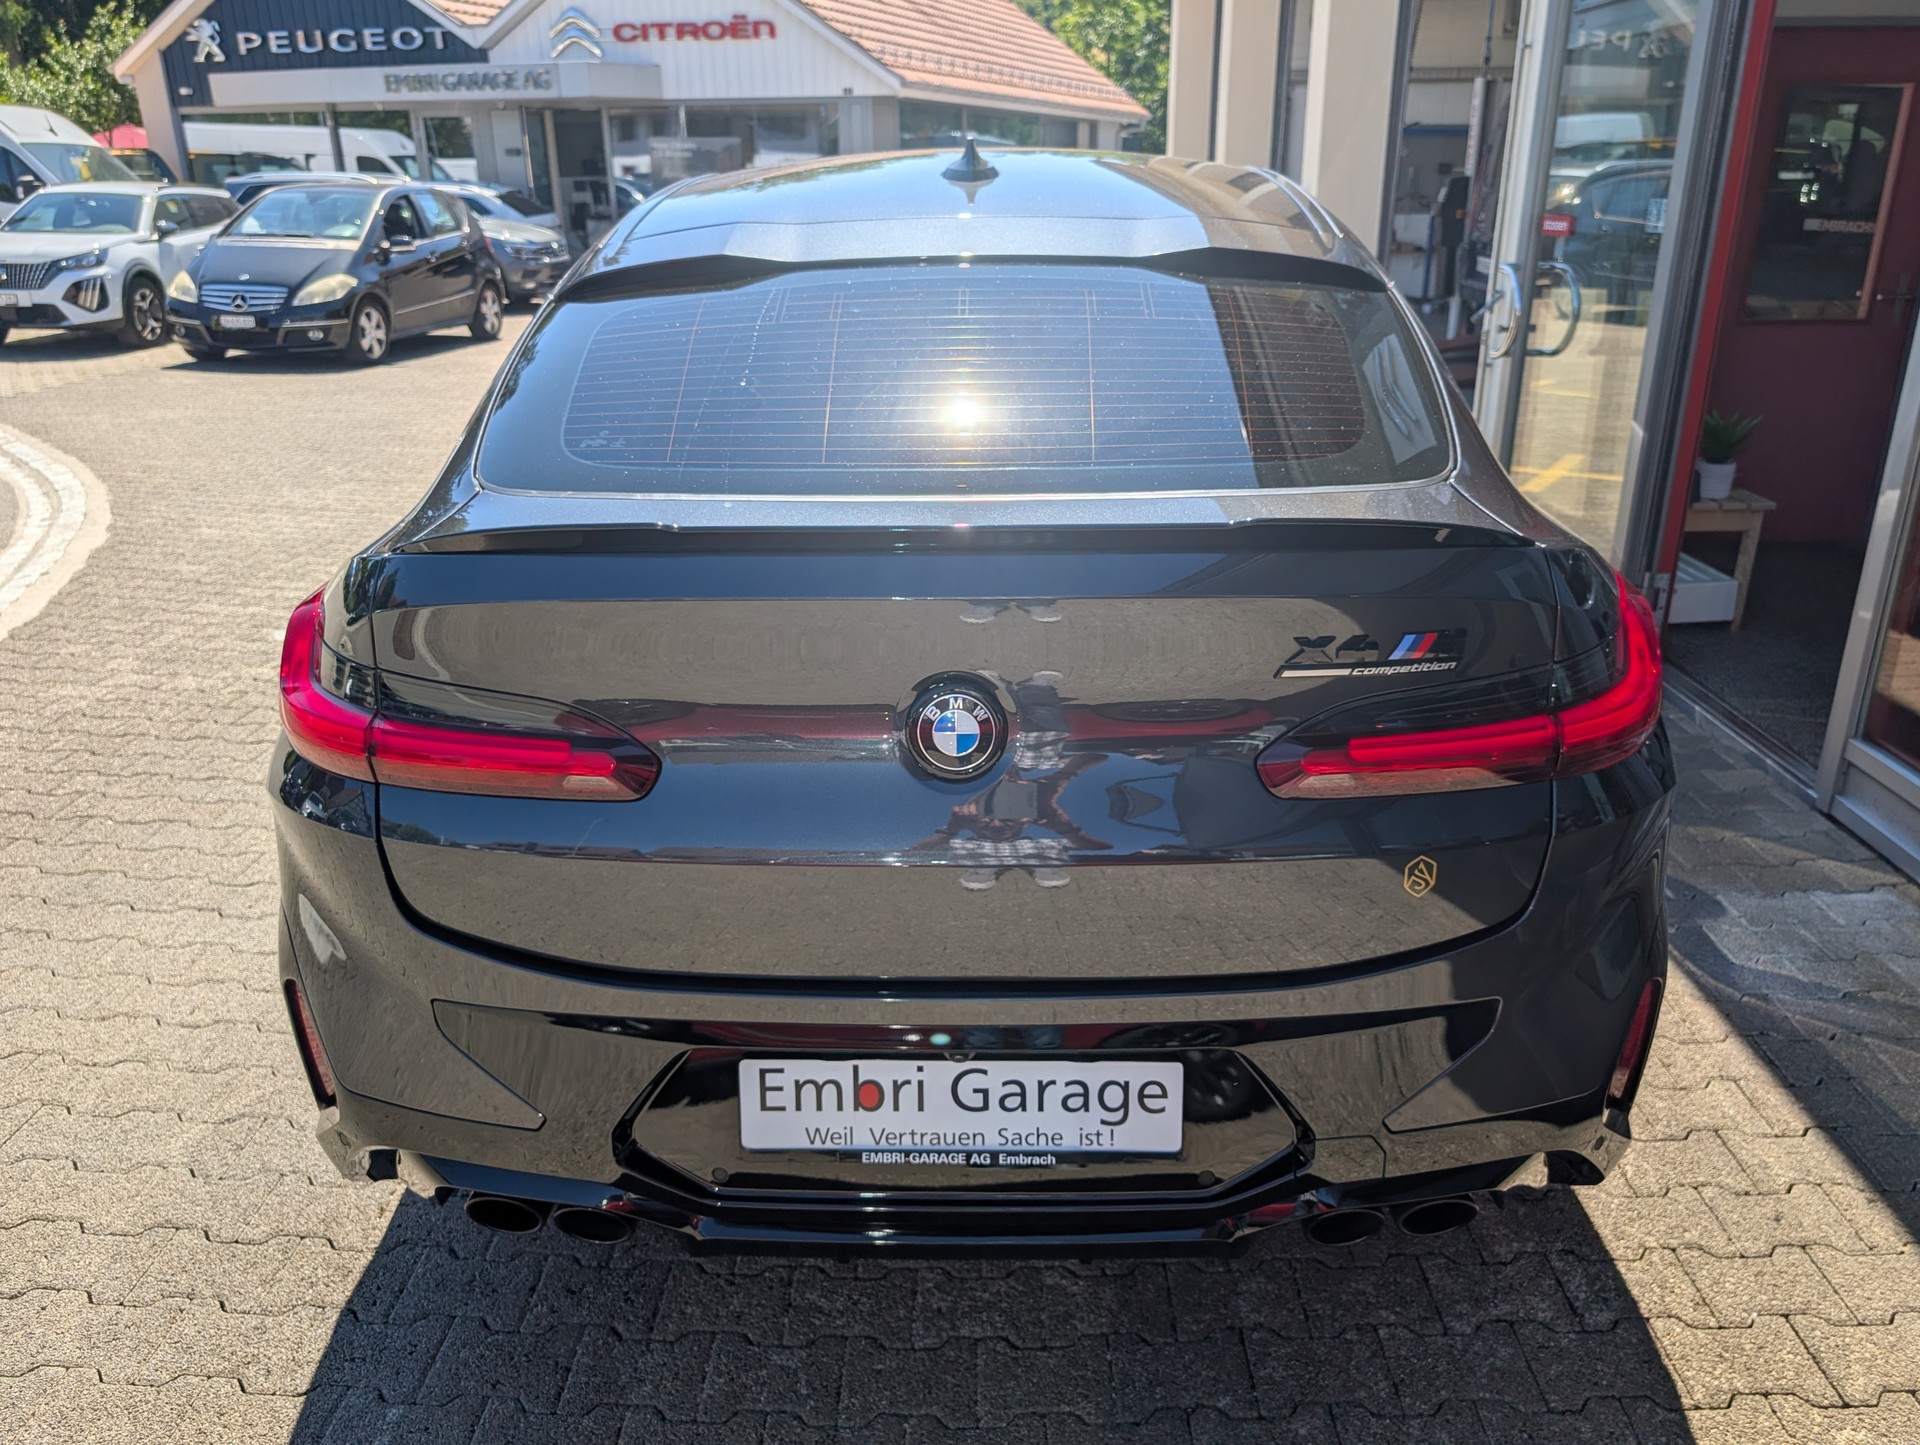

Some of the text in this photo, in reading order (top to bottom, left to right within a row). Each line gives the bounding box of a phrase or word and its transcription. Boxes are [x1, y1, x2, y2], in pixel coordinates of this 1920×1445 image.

[235, 26, 449, 55] PEUGEOT
[523, 68, 553, 90] AG
[1284, 633, 1380, 664] X4
[1351, 661, 1458, 676] competition
[925, 697, 989, 722] BMW
[758, 1064, 1169, 1127] Embri Garage
[805, 1126, 854, 1146] Weil
[869, 1126, 986, 1147] Vertrauen
[997, 1126, 1064, 1147] Sache
[861, 1151, 1057, 1166] EMBRI-GARAGE AG Embrach
